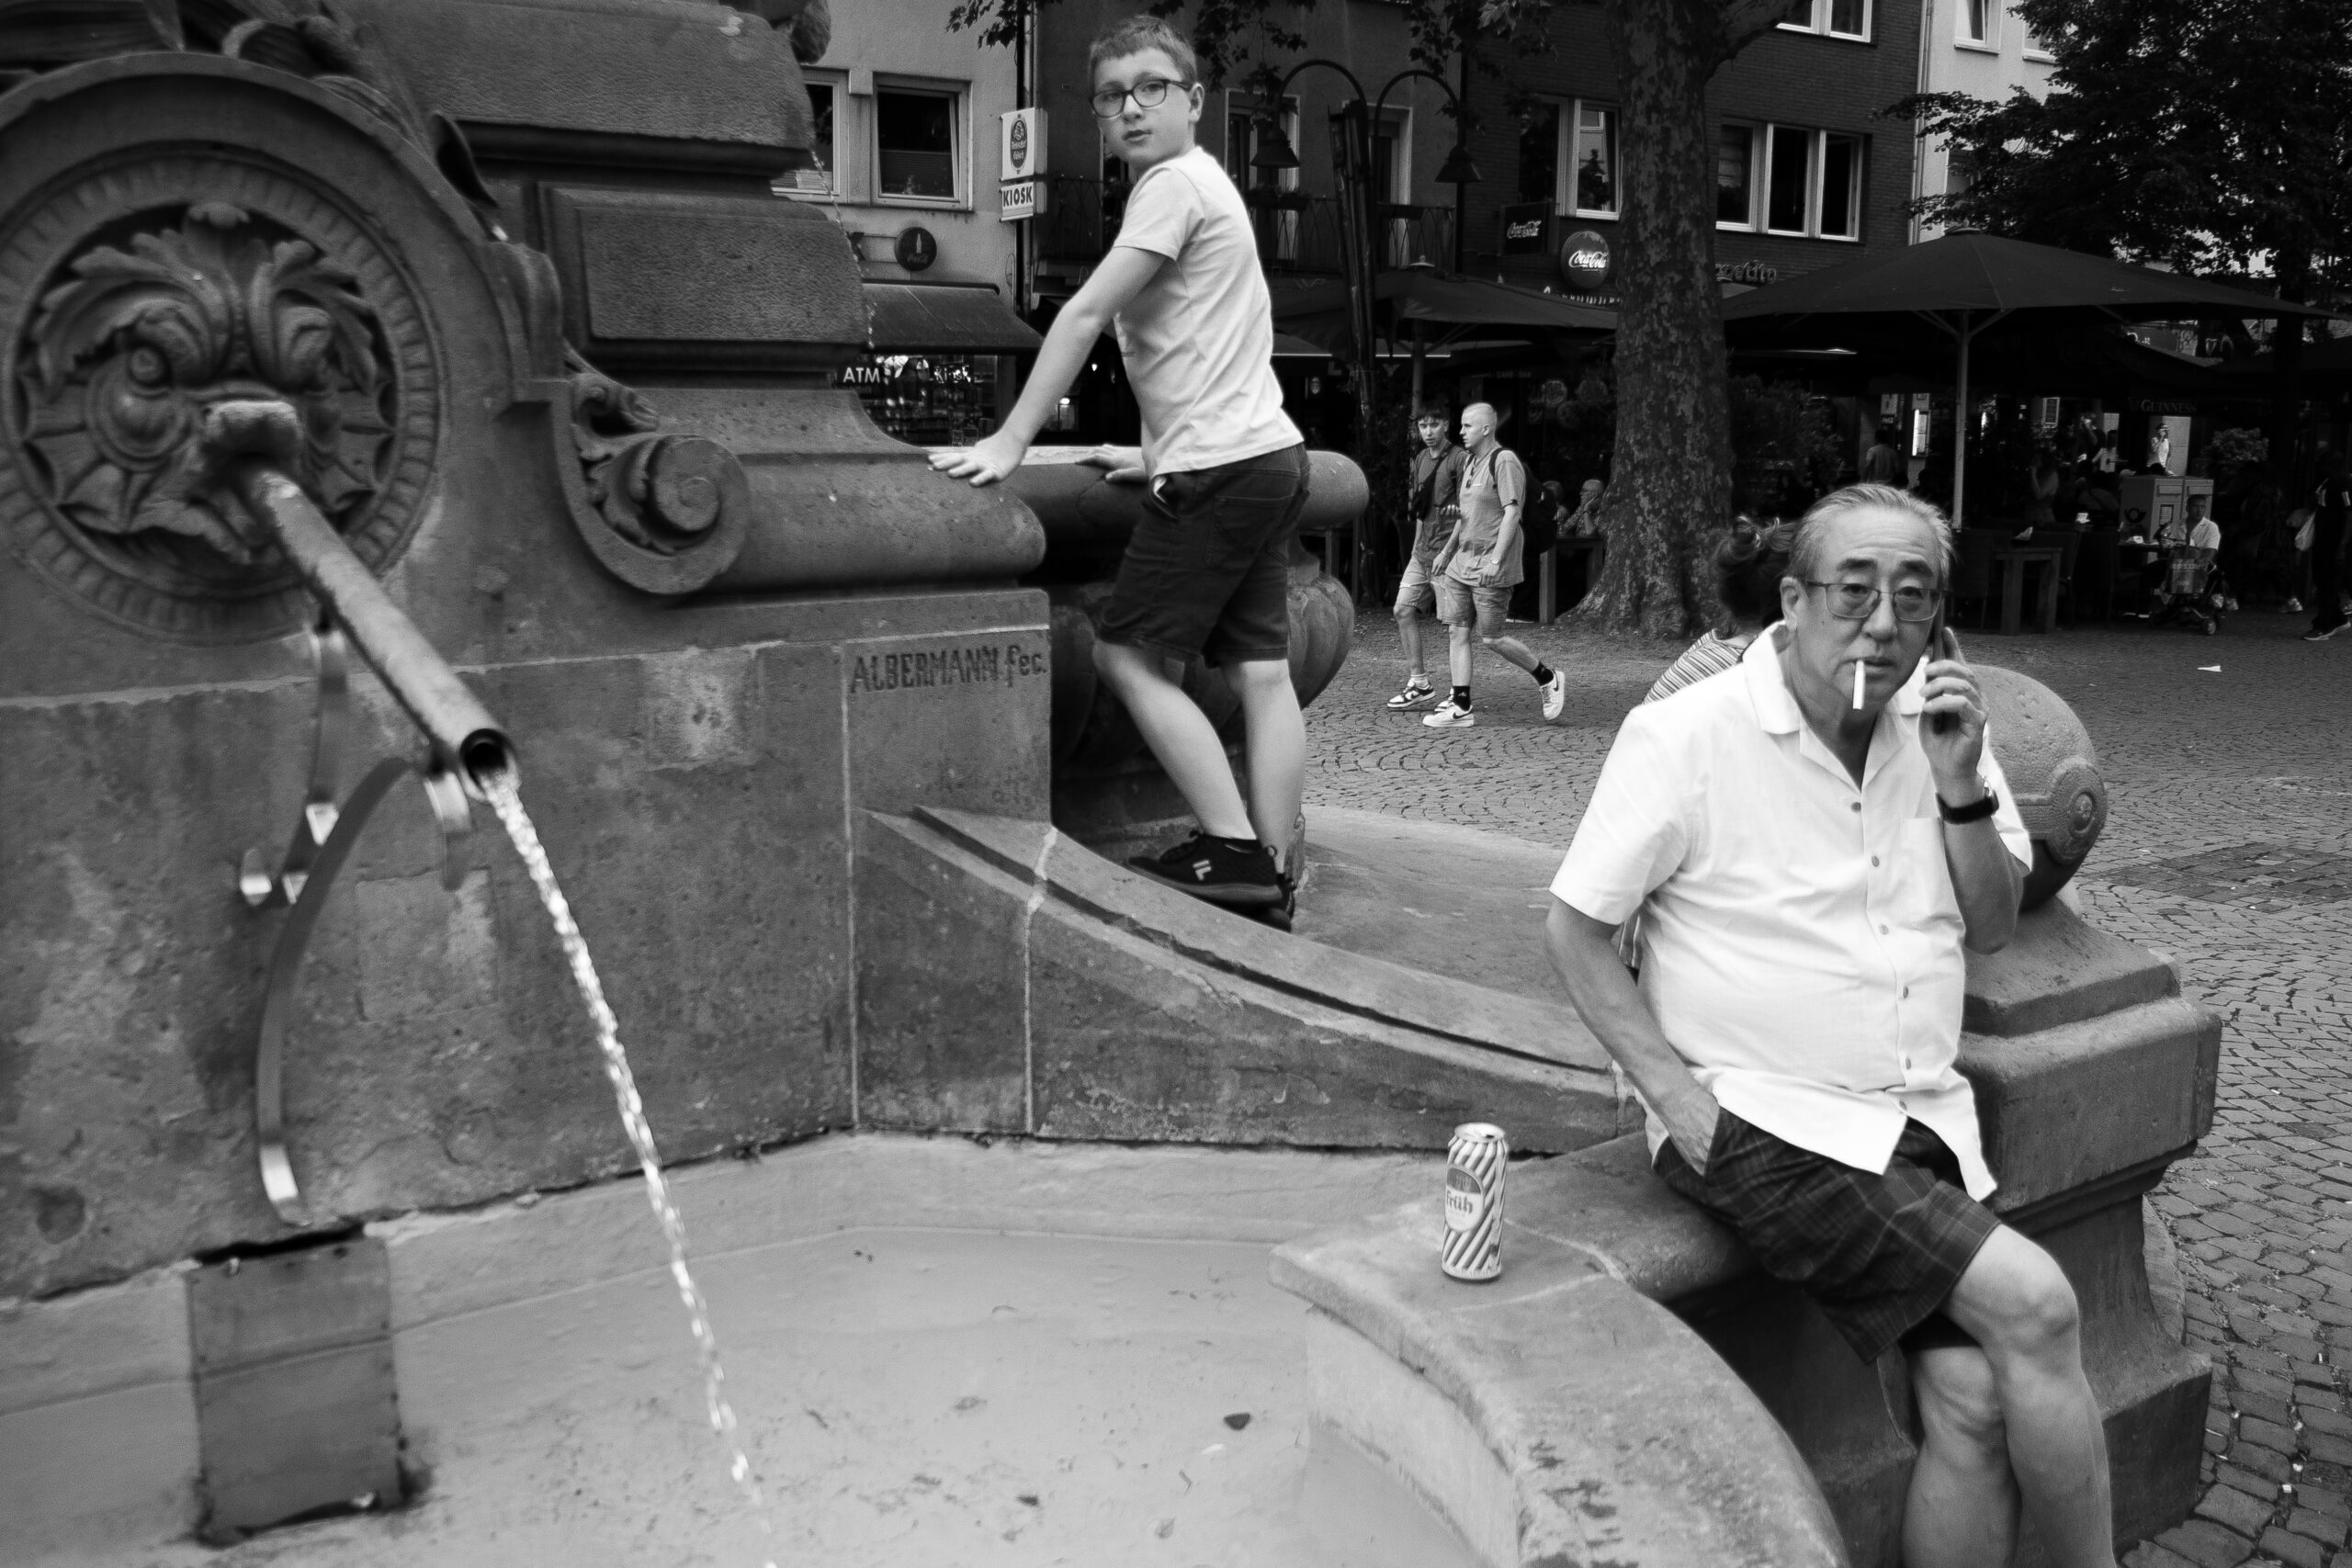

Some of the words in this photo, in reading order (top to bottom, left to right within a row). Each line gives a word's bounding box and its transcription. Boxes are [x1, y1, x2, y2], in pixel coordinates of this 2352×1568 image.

[1002, 186, 1033, 207] KIOSK
[1506, 220, 1542, 239] Coca-Cola
[1568, 250, 1609, 268] Coca-Cola
[842, 367, 881, 384] ATM
[850, 645, 1000, 694] ALBERMANN
